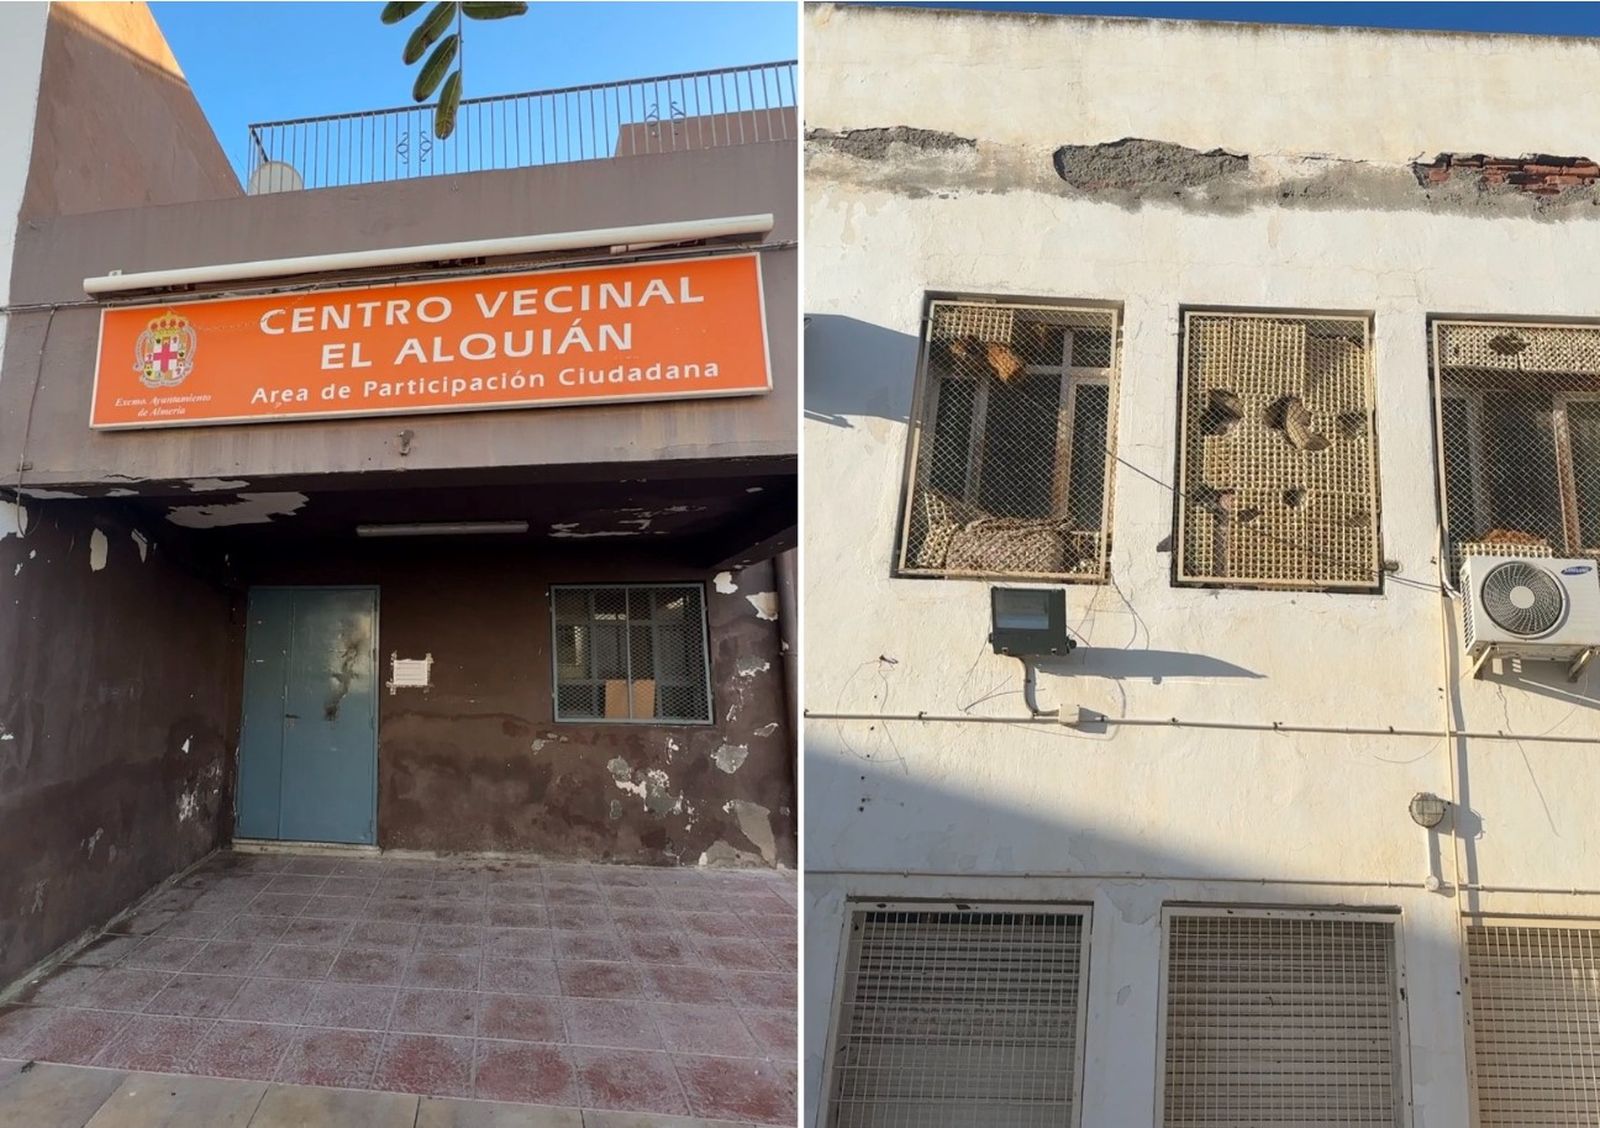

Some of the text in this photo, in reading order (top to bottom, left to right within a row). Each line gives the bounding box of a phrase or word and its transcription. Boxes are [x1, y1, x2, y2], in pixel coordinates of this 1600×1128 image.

[259, 276, 705, 335] CENTRO VECINAL
[320, 318, 632, 370] EL ALQUIÁN
[149, 394, 211, 406] Ayuntamiento
[251, 361, 719, 404] Area de Participación Ciudadana
[138, 408, 149, 417] de
